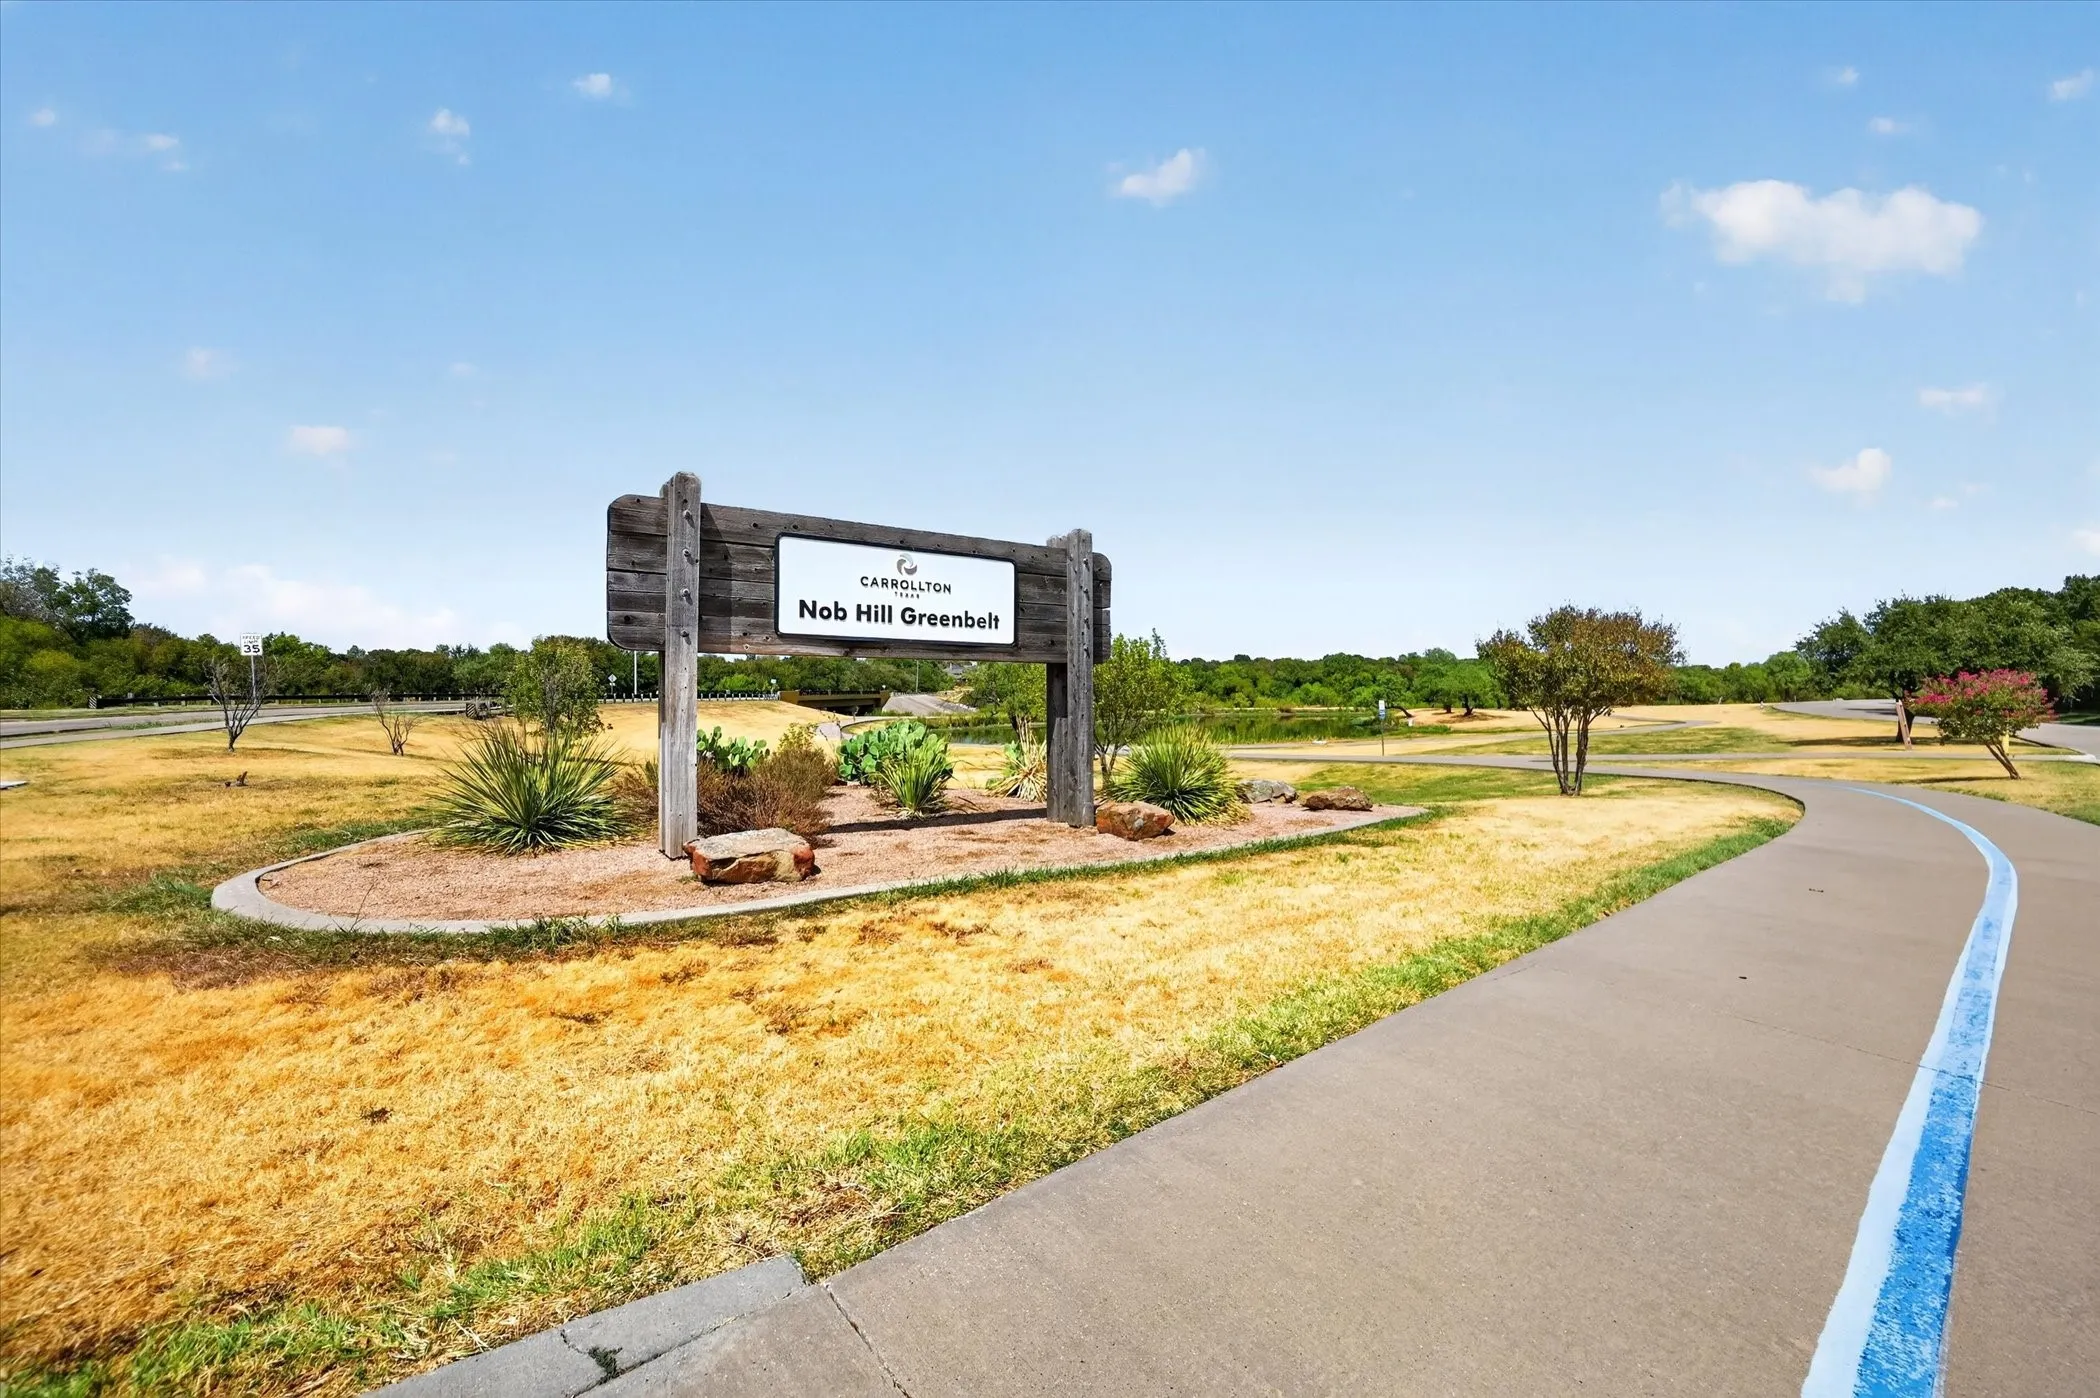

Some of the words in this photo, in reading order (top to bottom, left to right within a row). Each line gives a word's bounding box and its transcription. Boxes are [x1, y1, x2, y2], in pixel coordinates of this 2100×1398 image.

[860, 576, 951, 594] CARROLLTON
[799, 599, 848, 621] Nob
[856, 603, 893, 624] Hill
[900, 606, 1000, 630] Greenbelt
[243, 644, 260, 653] 35
